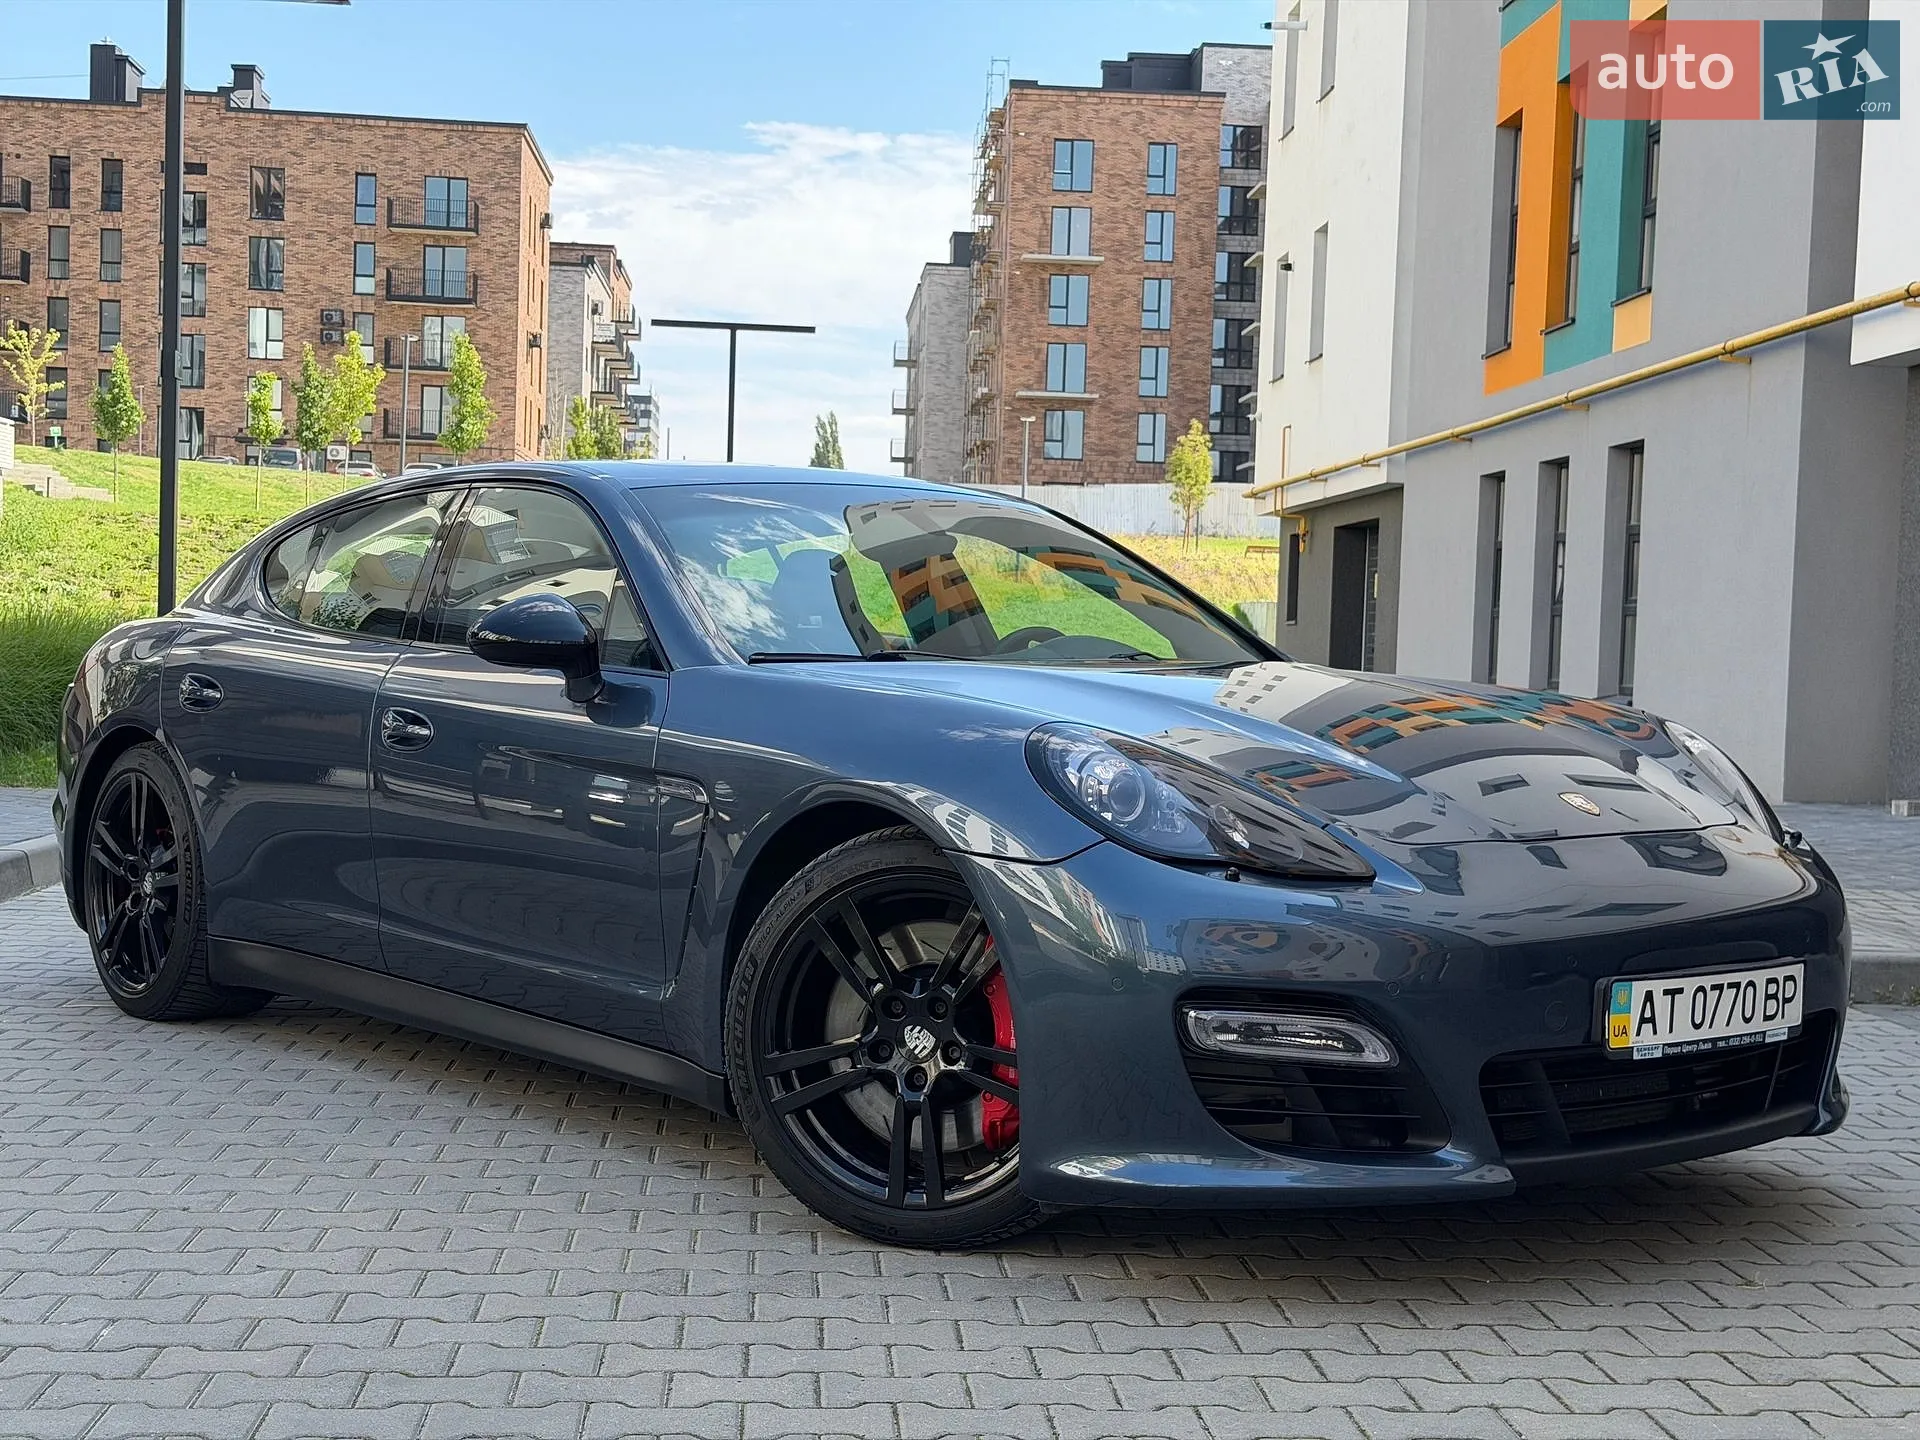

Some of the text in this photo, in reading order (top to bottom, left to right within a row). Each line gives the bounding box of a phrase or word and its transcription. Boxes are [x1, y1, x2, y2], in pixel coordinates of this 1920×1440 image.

[733, 957, 757, 1088] MICHELIN
[1613, 1025, 1628, 1038] UA
[1636, 975, 1797, 1036] AT 0770 BP
